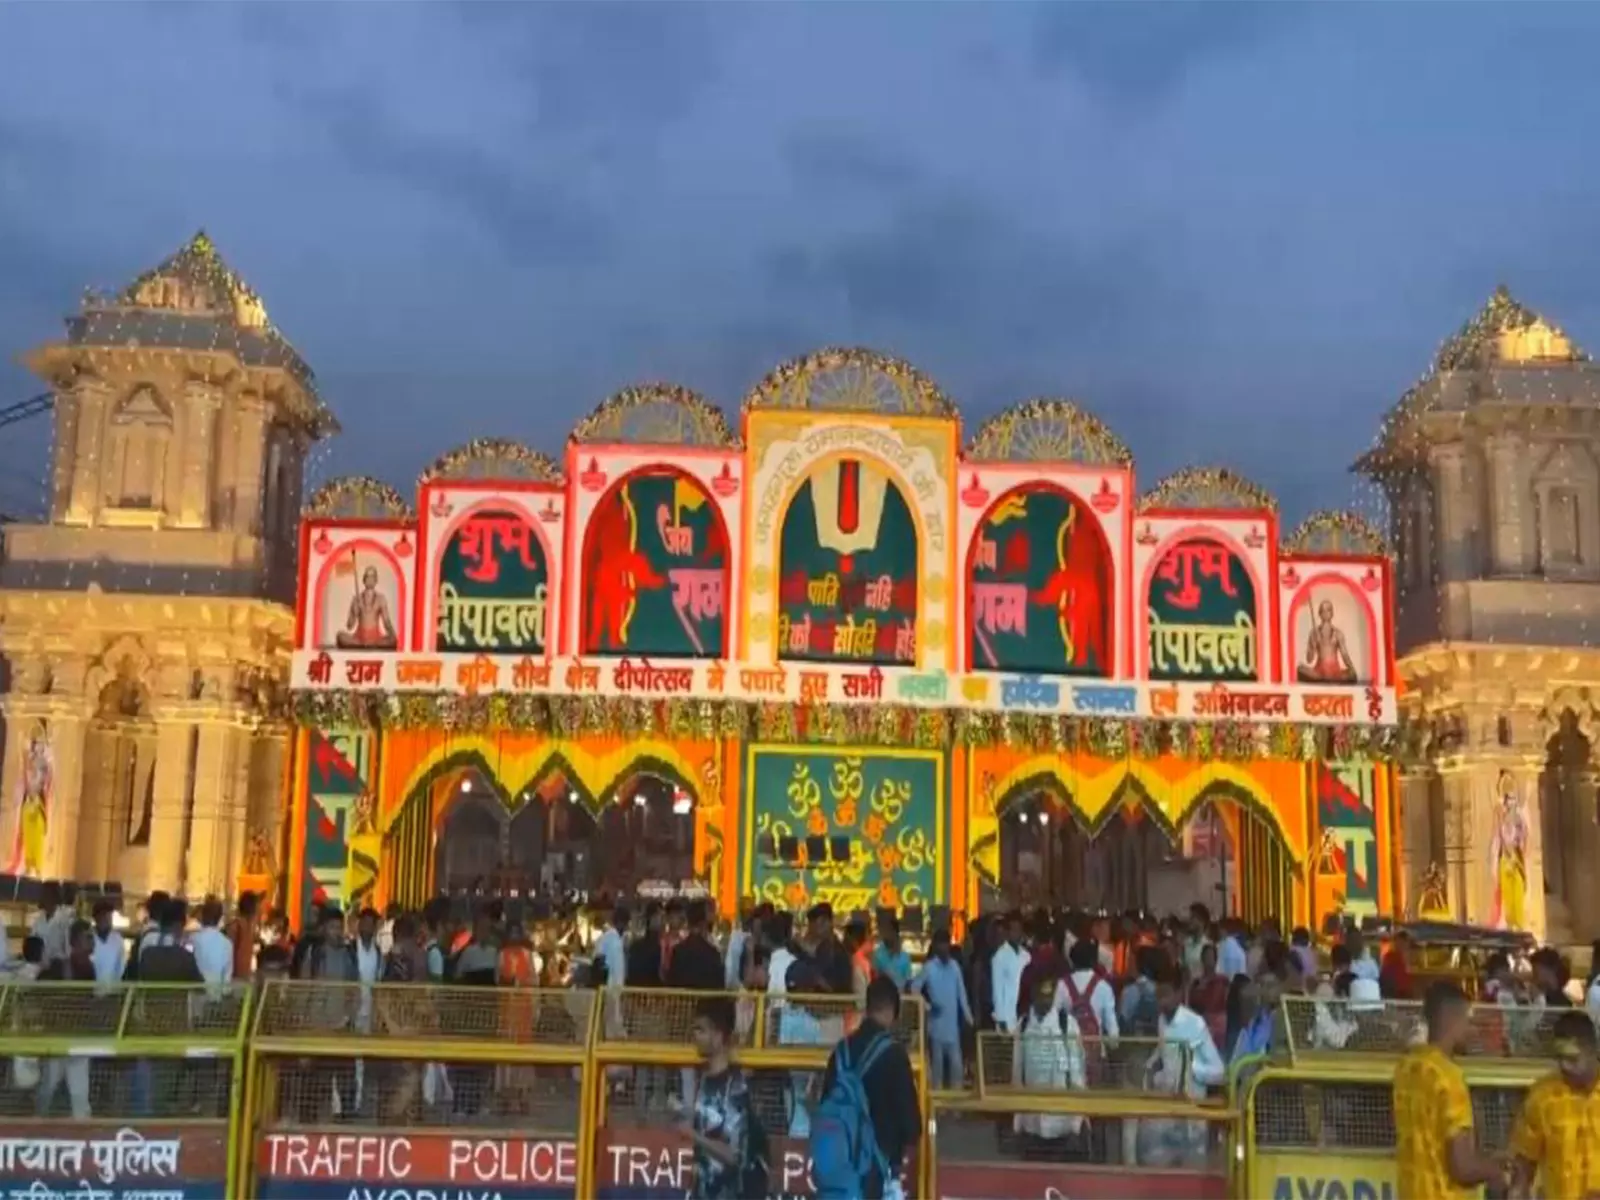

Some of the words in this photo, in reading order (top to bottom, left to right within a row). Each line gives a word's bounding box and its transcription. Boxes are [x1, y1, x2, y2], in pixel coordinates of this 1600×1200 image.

[306, 650, 333, 686] श्री
[345, 658, 384, 685] राम
[613, 655, 694, 692] दीपोत्सव
[841, 664, 884, 698] सभी
[89, 1126, 181, 1183] पुलिस
[266, 1135, 412, 1178] TRAFFIC
[449, 1139, 577, 1183] POLICE
[606, 1145, 695, 1189] TRAF
